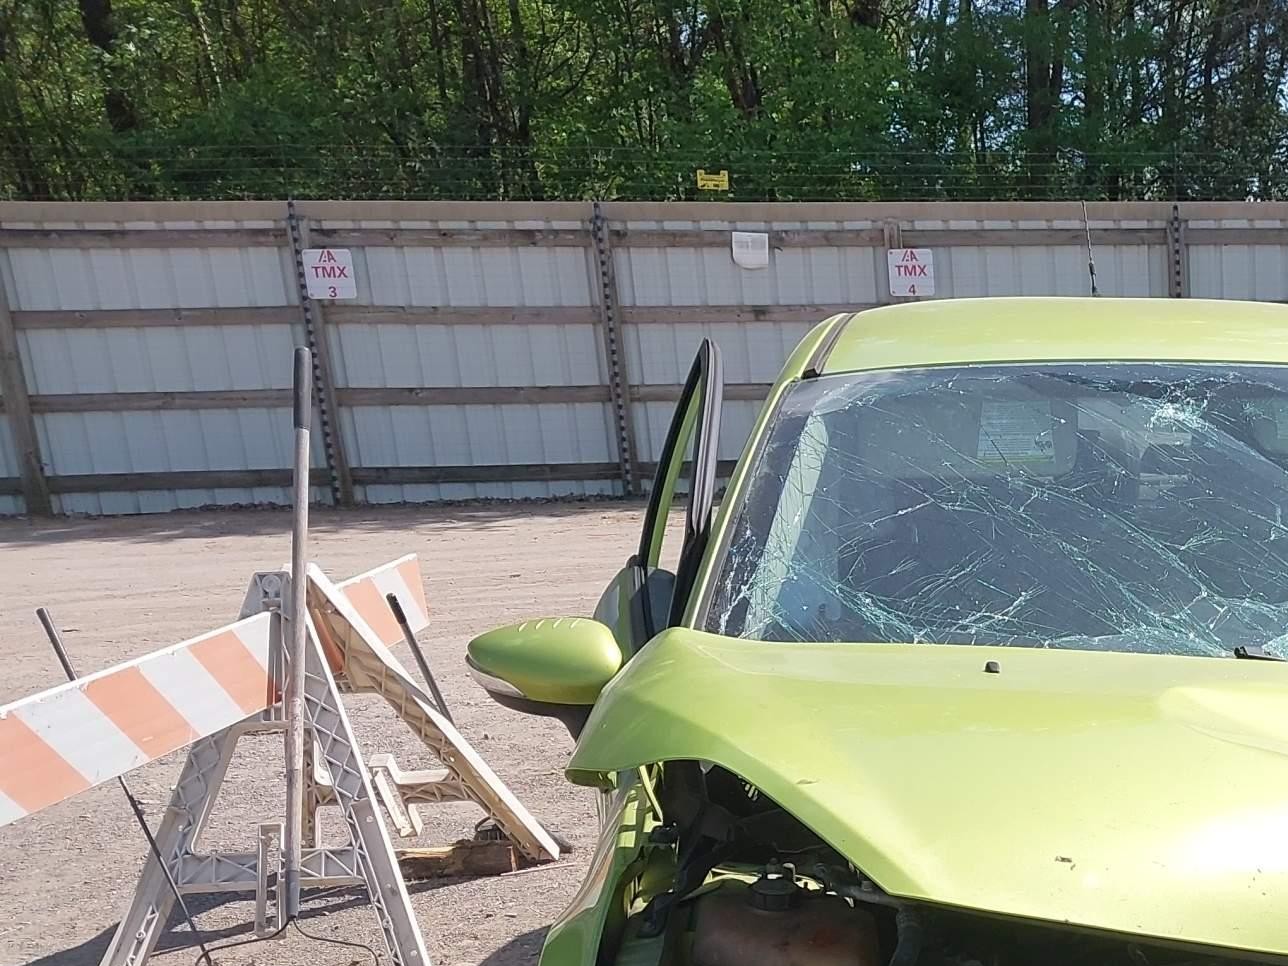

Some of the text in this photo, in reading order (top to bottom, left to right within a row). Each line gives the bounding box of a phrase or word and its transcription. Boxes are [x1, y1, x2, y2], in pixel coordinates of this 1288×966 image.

[311, 266, 348, 279] TMX
[894, 264, 928, 277] TMX
[328, 286, 337, 298] 3
[908, 283, 917, 295] 4
